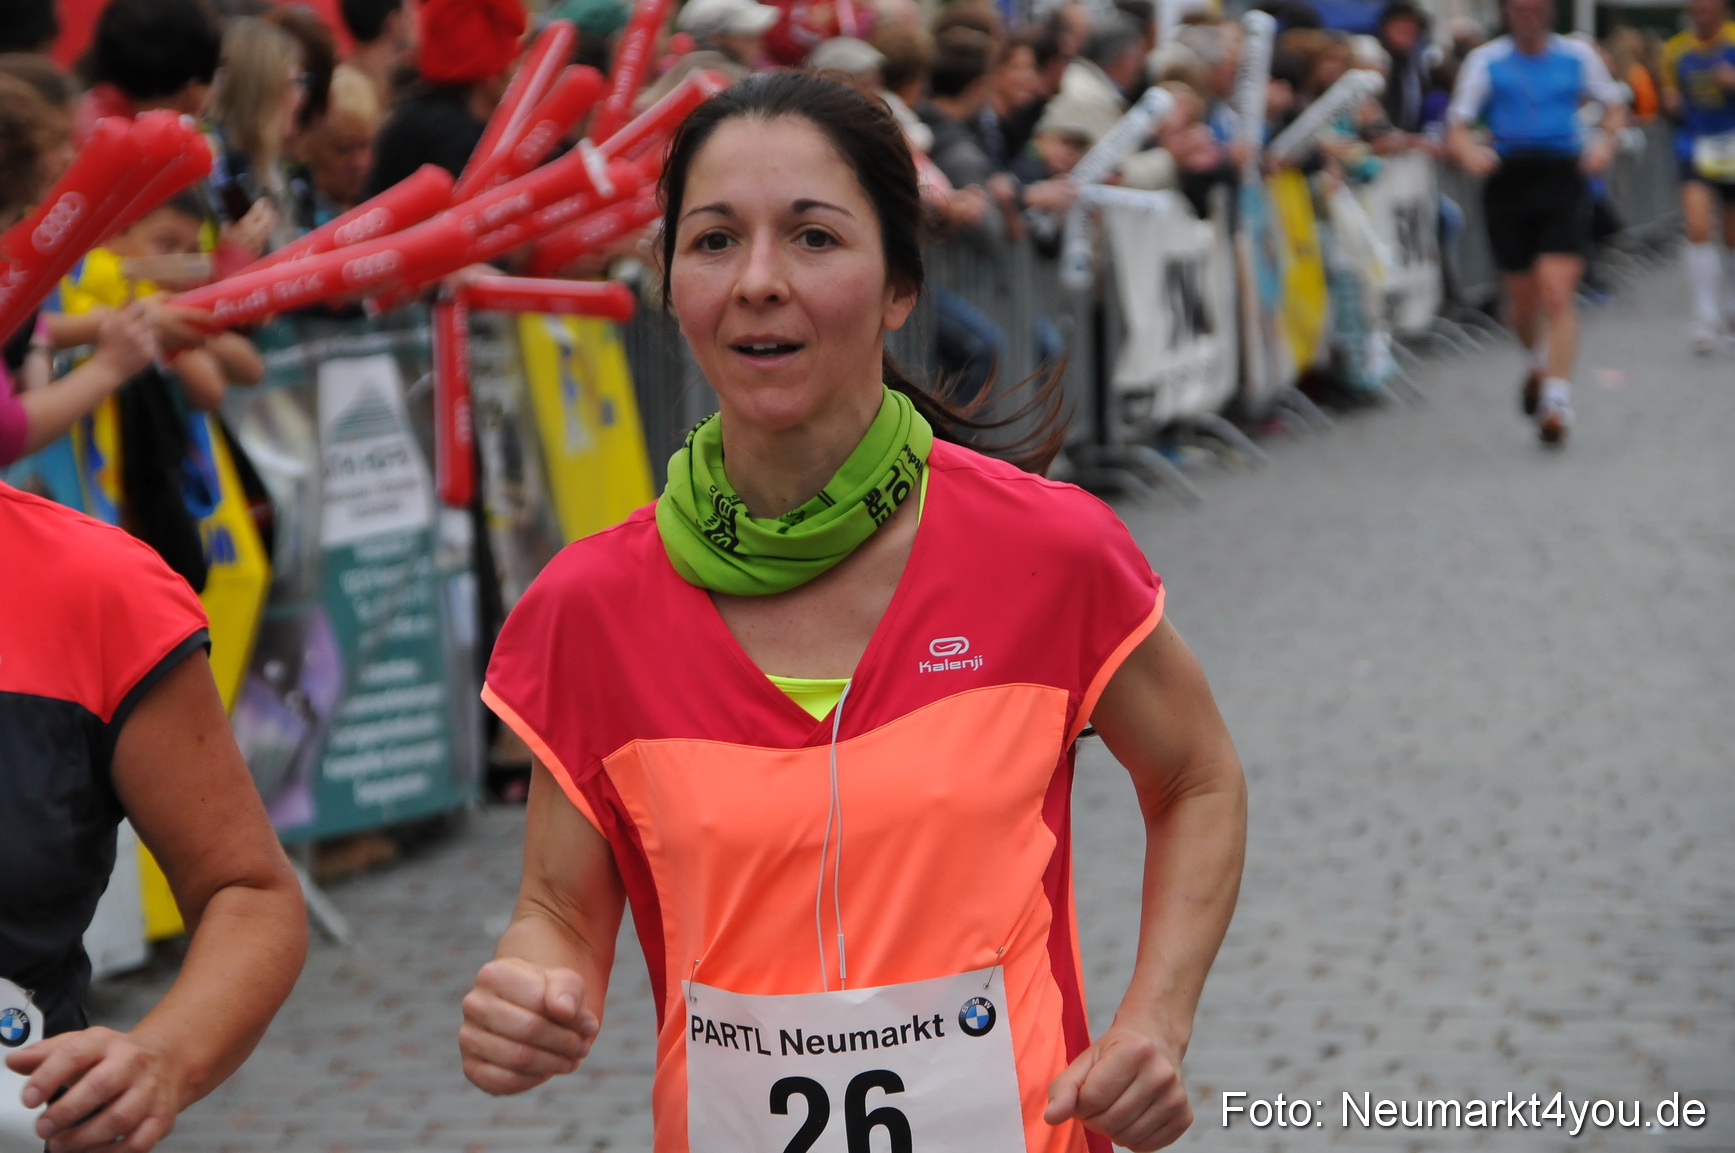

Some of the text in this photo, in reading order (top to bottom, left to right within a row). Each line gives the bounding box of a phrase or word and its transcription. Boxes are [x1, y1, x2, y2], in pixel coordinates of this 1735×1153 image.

[919, 654, 983, 673] Kalenji
[961, 997, 993, 1014] BMW
[691, 1013, 945, 1056] PARTL Neumarkt
[769, 1069, 913, 1153] 26
